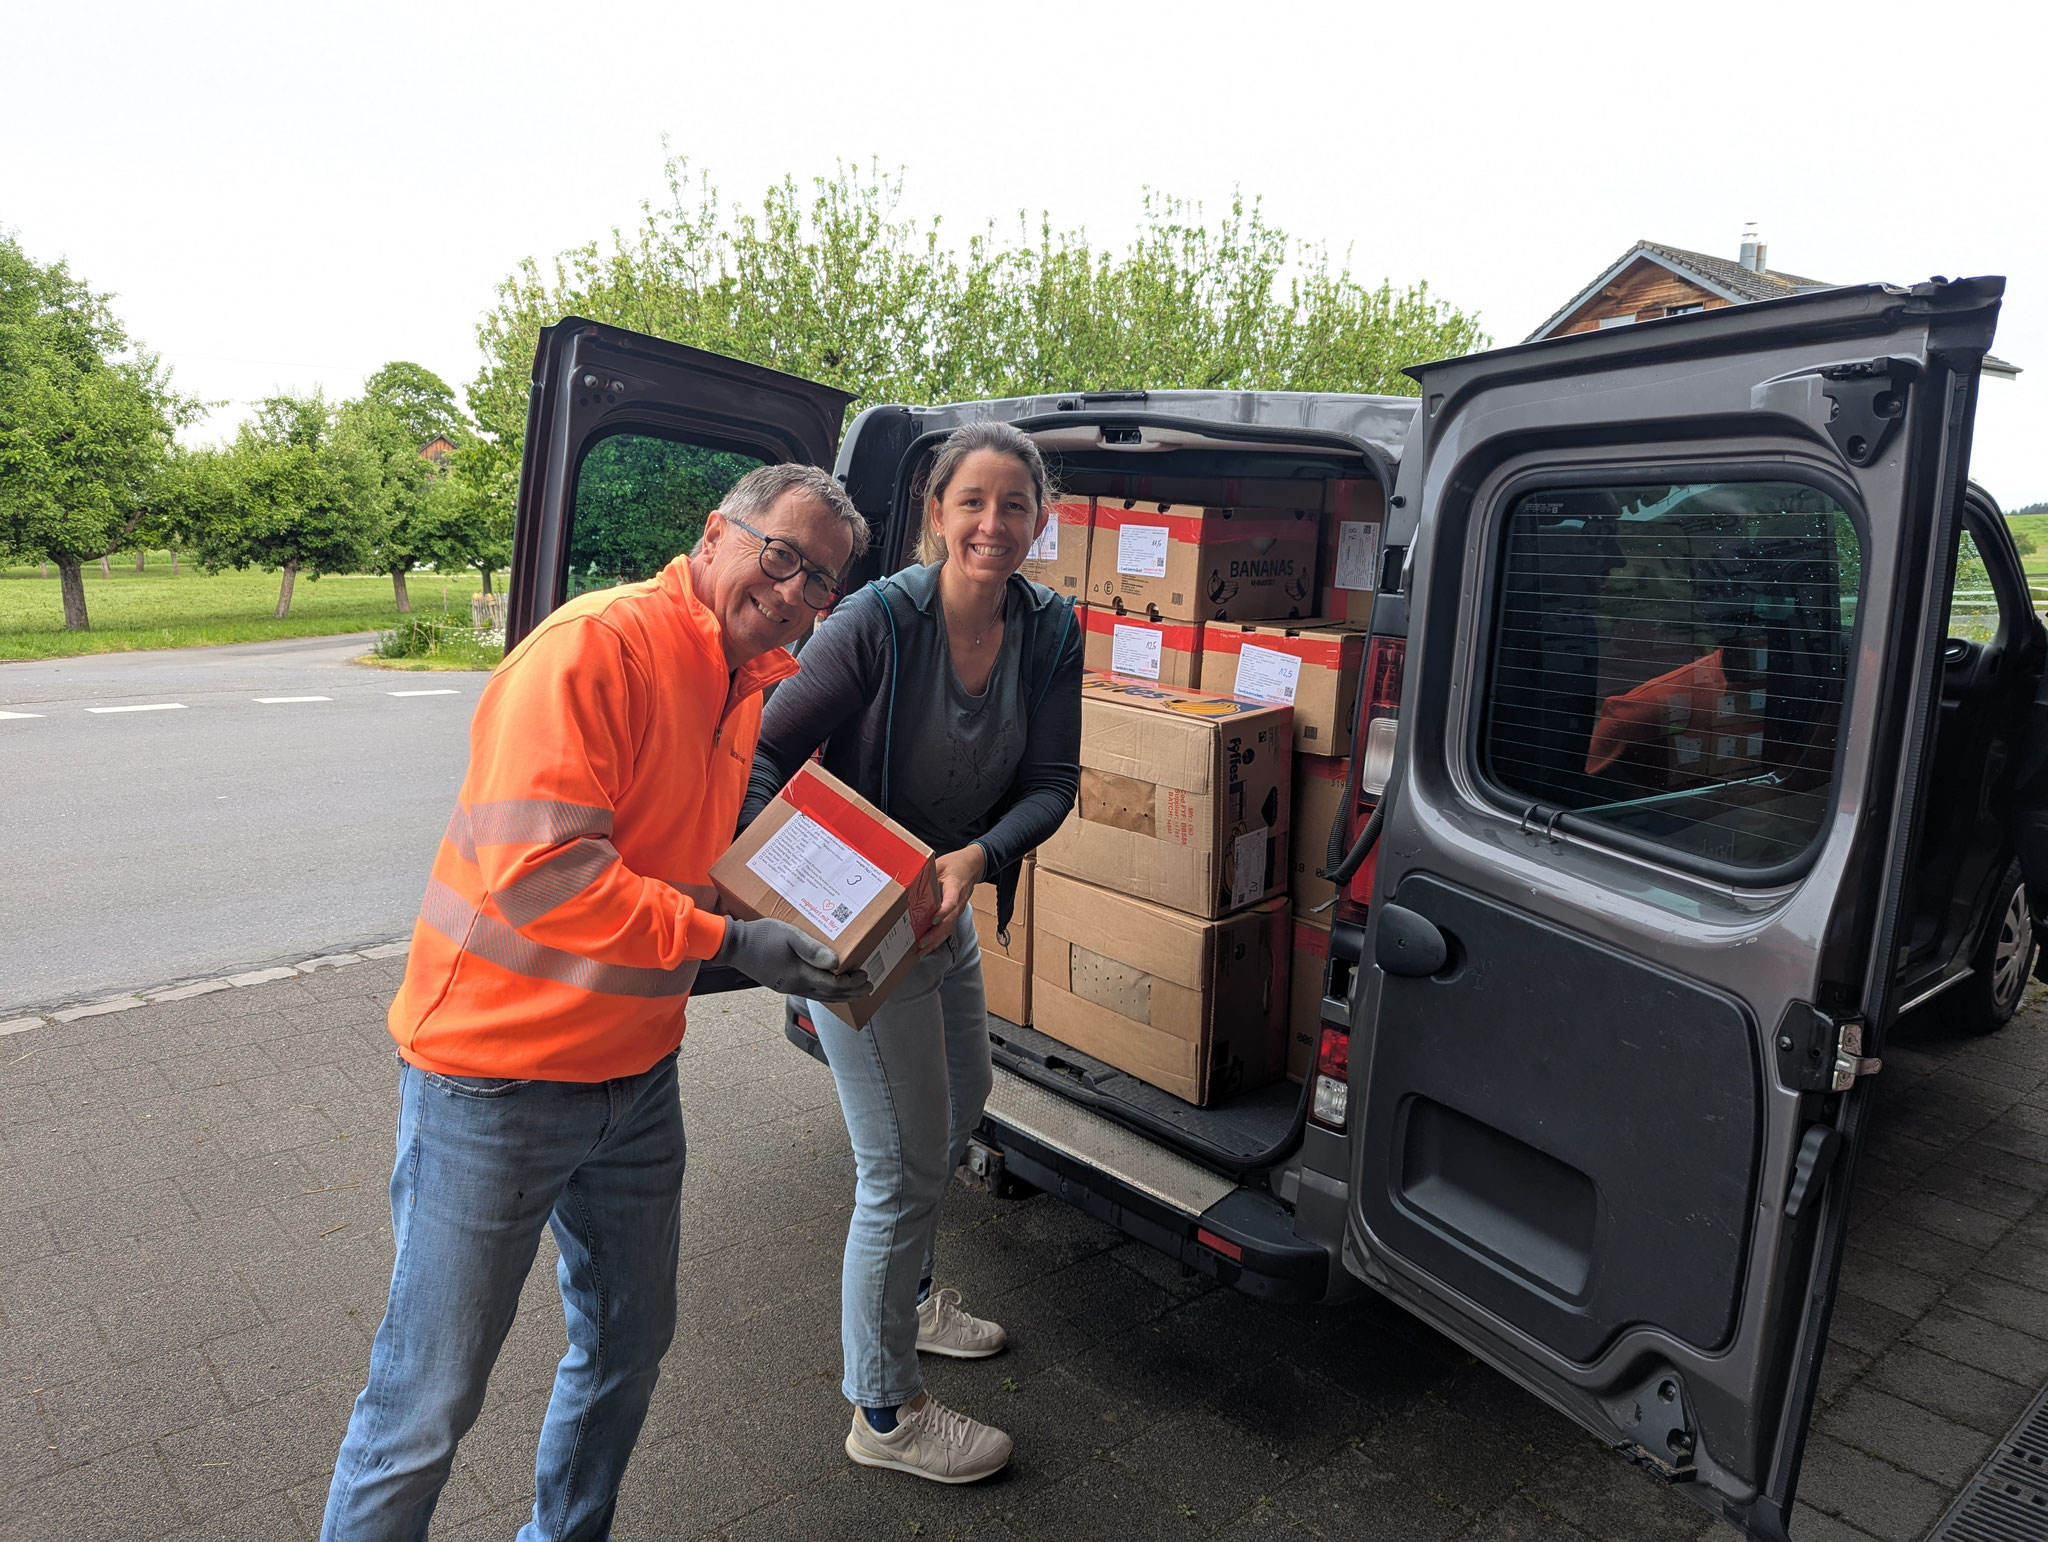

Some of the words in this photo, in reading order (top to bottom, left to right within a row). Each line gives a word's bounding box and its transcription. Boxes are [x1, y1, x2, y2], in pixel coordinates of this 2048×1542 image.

[1230, 560, 1294, 578] BANANAS
[1146, 641, 1157, 651] 12,5
[1279, 667, 1293, 678] 12,5
[846, 875, 862, 886] 3
[801, 897, 822, 916] engagiert
[821, 914, 830, 922] mit
[828, 920, 840, 931] Herz
